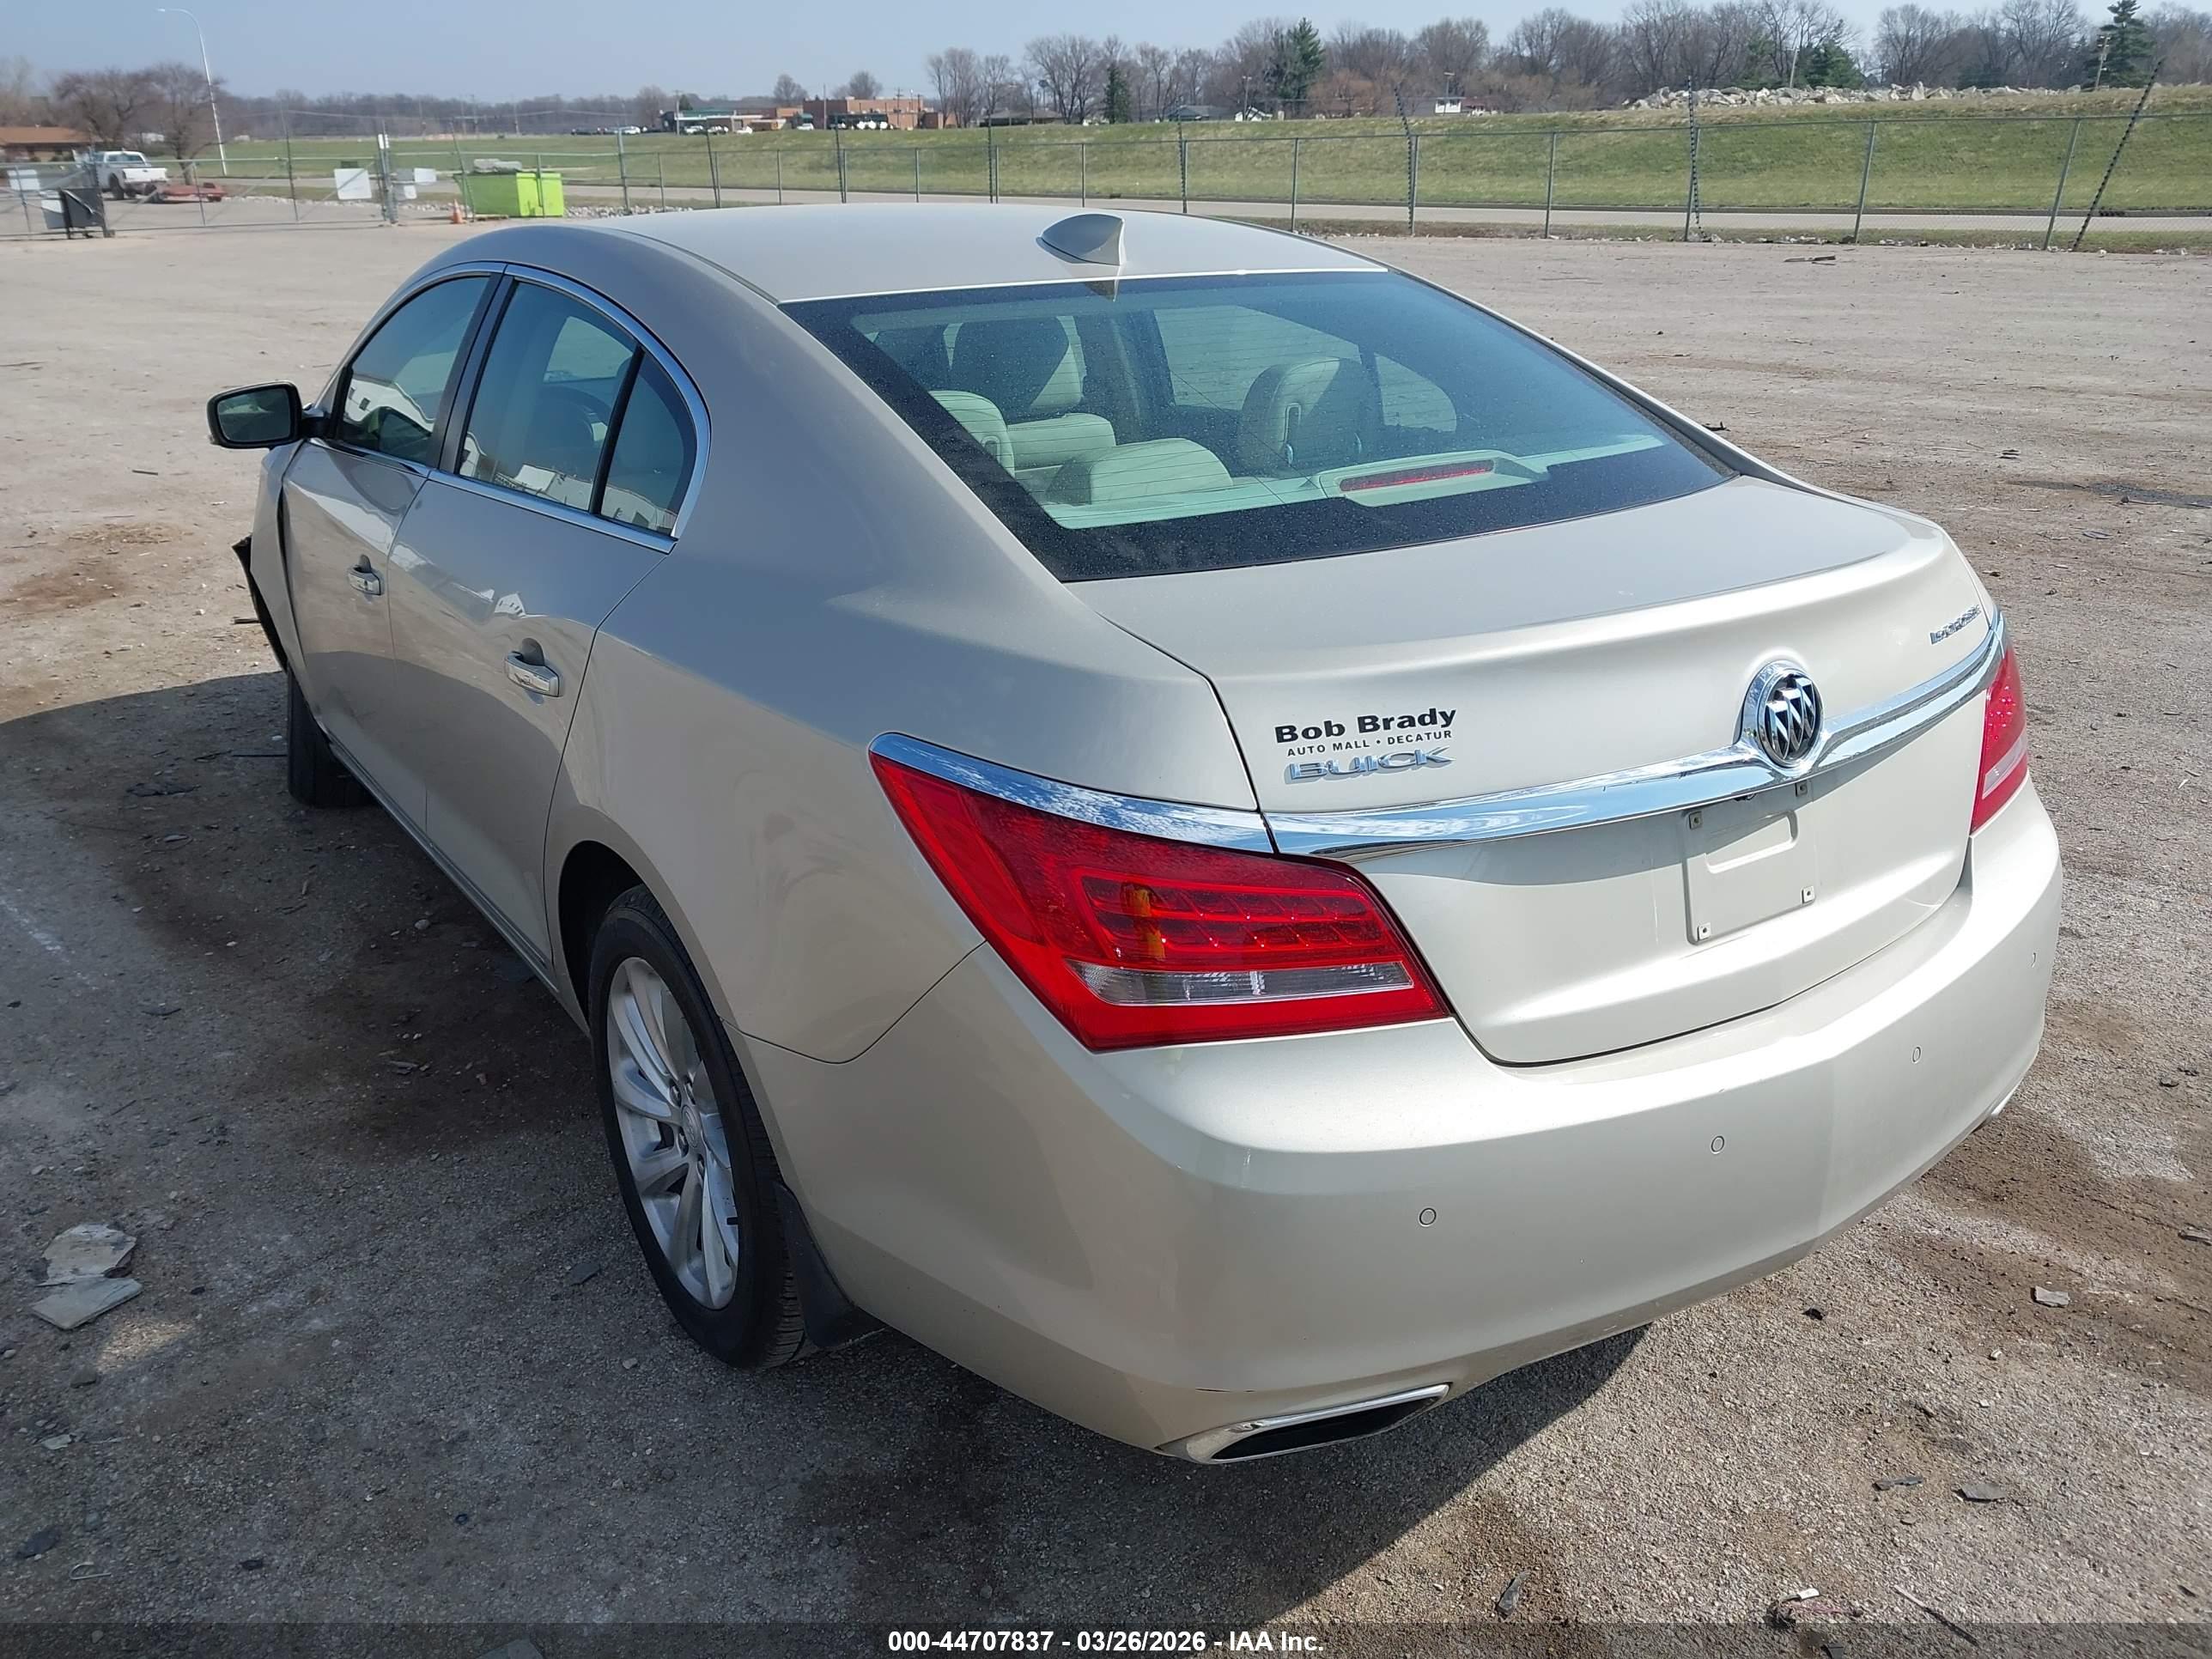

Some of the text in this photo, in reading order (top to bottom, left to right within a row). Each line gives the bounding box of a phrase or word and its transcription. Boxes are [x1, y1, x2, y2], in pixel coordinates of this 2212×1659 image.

[1274, 708, 1457, 744] Bob Brady
[1286, 730, 1452, 757] AUTO MALL DECATUR
[1287, 746, 1456, 781] BUICK
